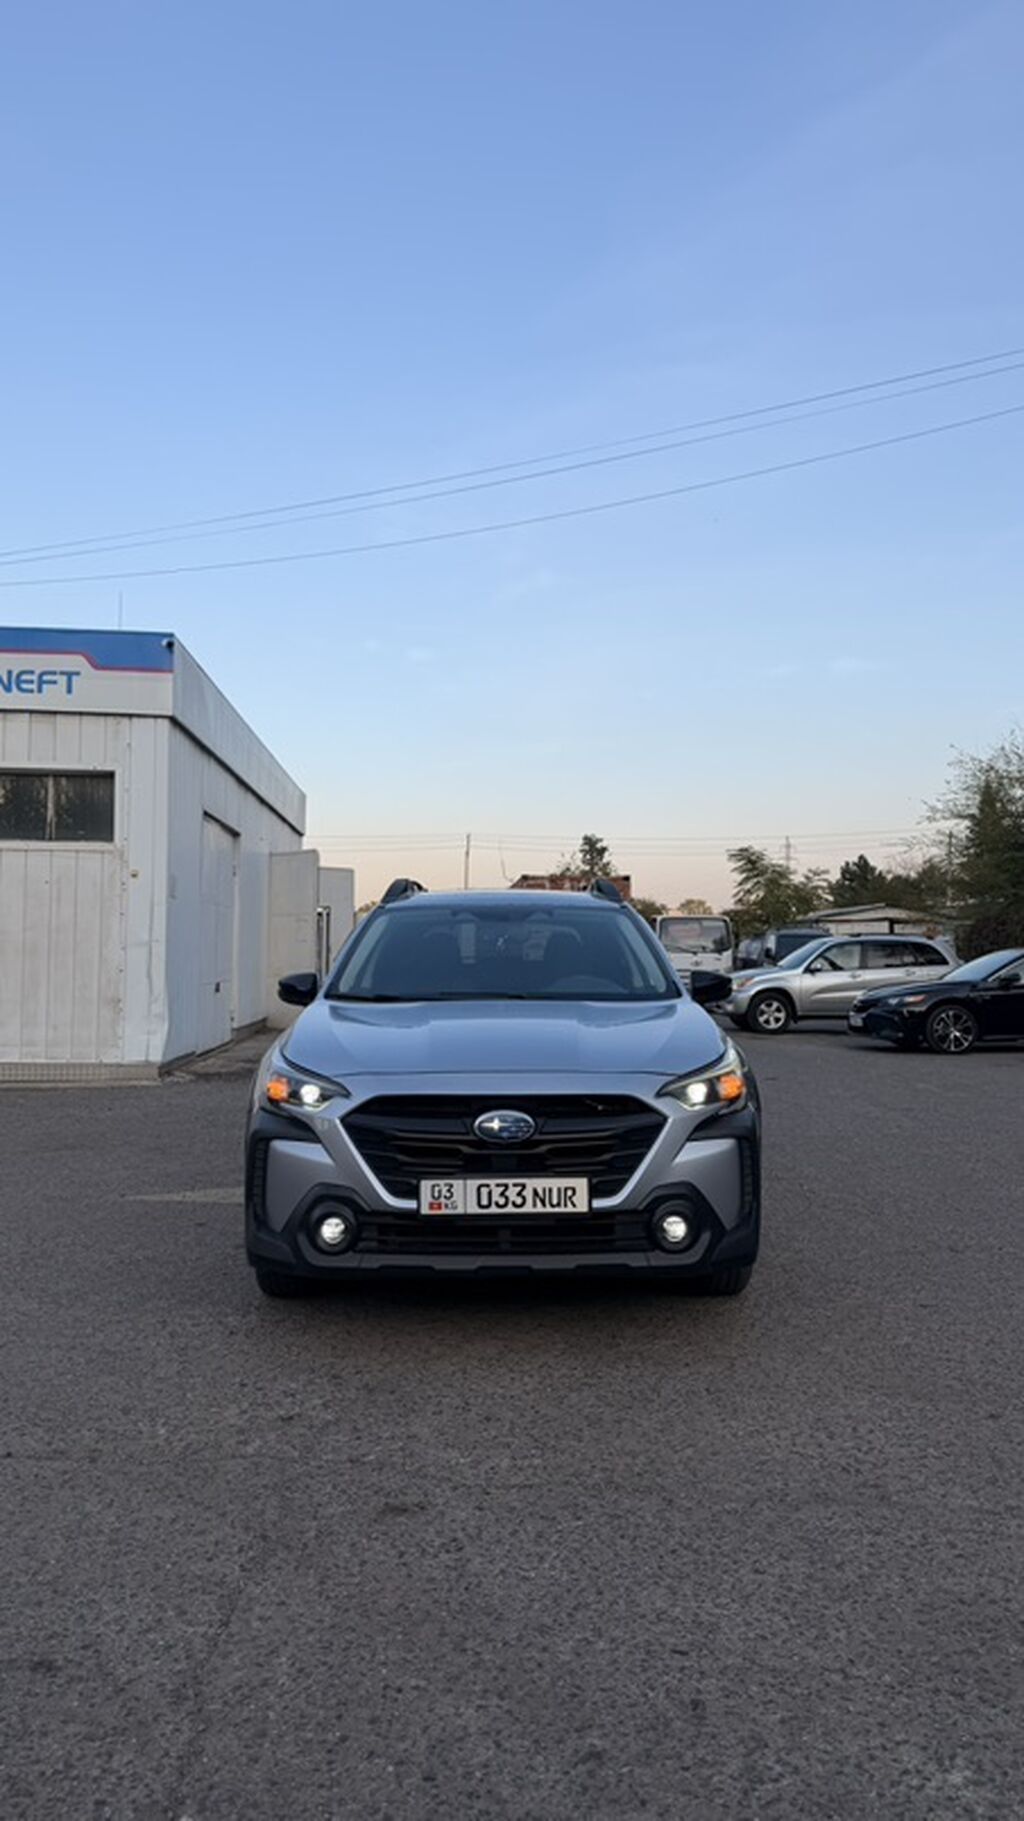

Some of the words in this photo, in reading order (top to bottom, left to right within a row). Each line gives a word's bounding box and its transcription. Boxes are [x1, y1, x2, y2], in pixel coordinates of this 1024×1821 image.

[431, 1183, 454, 1201] 03
[476, 1183, 527, 1209] 033
[532, 1186, 577, 1209] NUR
